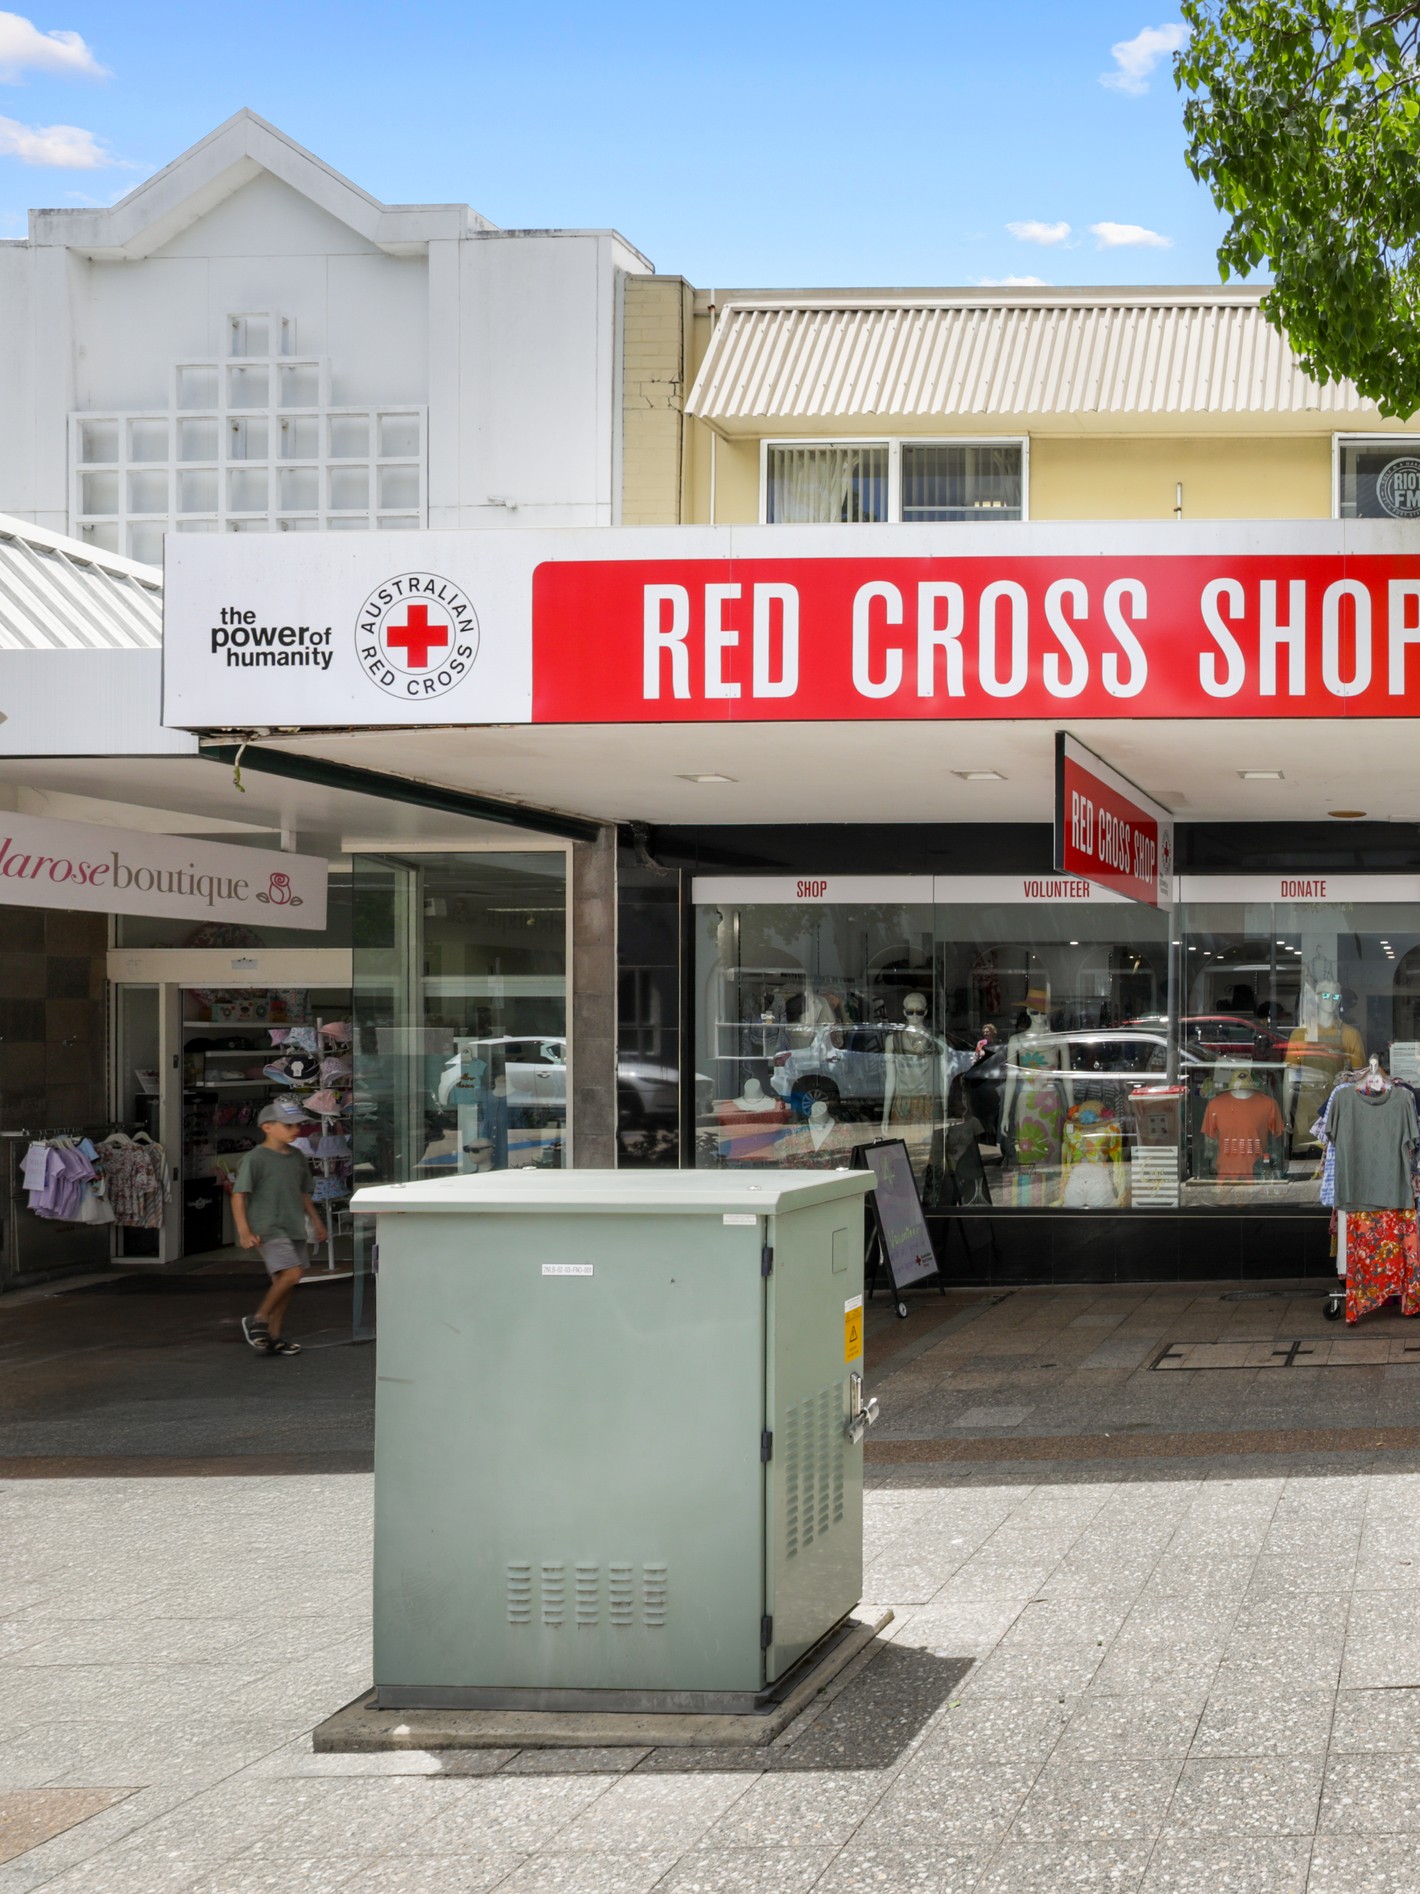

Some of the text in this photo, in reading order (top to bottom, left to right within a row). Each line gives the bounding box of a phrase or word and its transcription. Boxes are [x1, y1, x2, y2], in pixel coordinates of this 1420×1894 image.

[220, 607, 256, 625] the
[360, 577, 474, 635] AUSTRALIAN
[211, 626, 332, 653] power of
[642, 582, 800, 699] RED
[852, 578, 1148, 699] CROSS
[227, 647, 333, 670] humanity
[361, 644, 472, 696] RED CROSS
[1072, 790, 1094, 856] RED
[1098, 808, 1131, 874] CROSS
[1134, 829, 1156, 885] SHOP
[796, 880, 827, 898] SHOP
[1023, 880, 1090, 898] VOLUNTEER
[1281, 880, 1327, 898] DONATE
